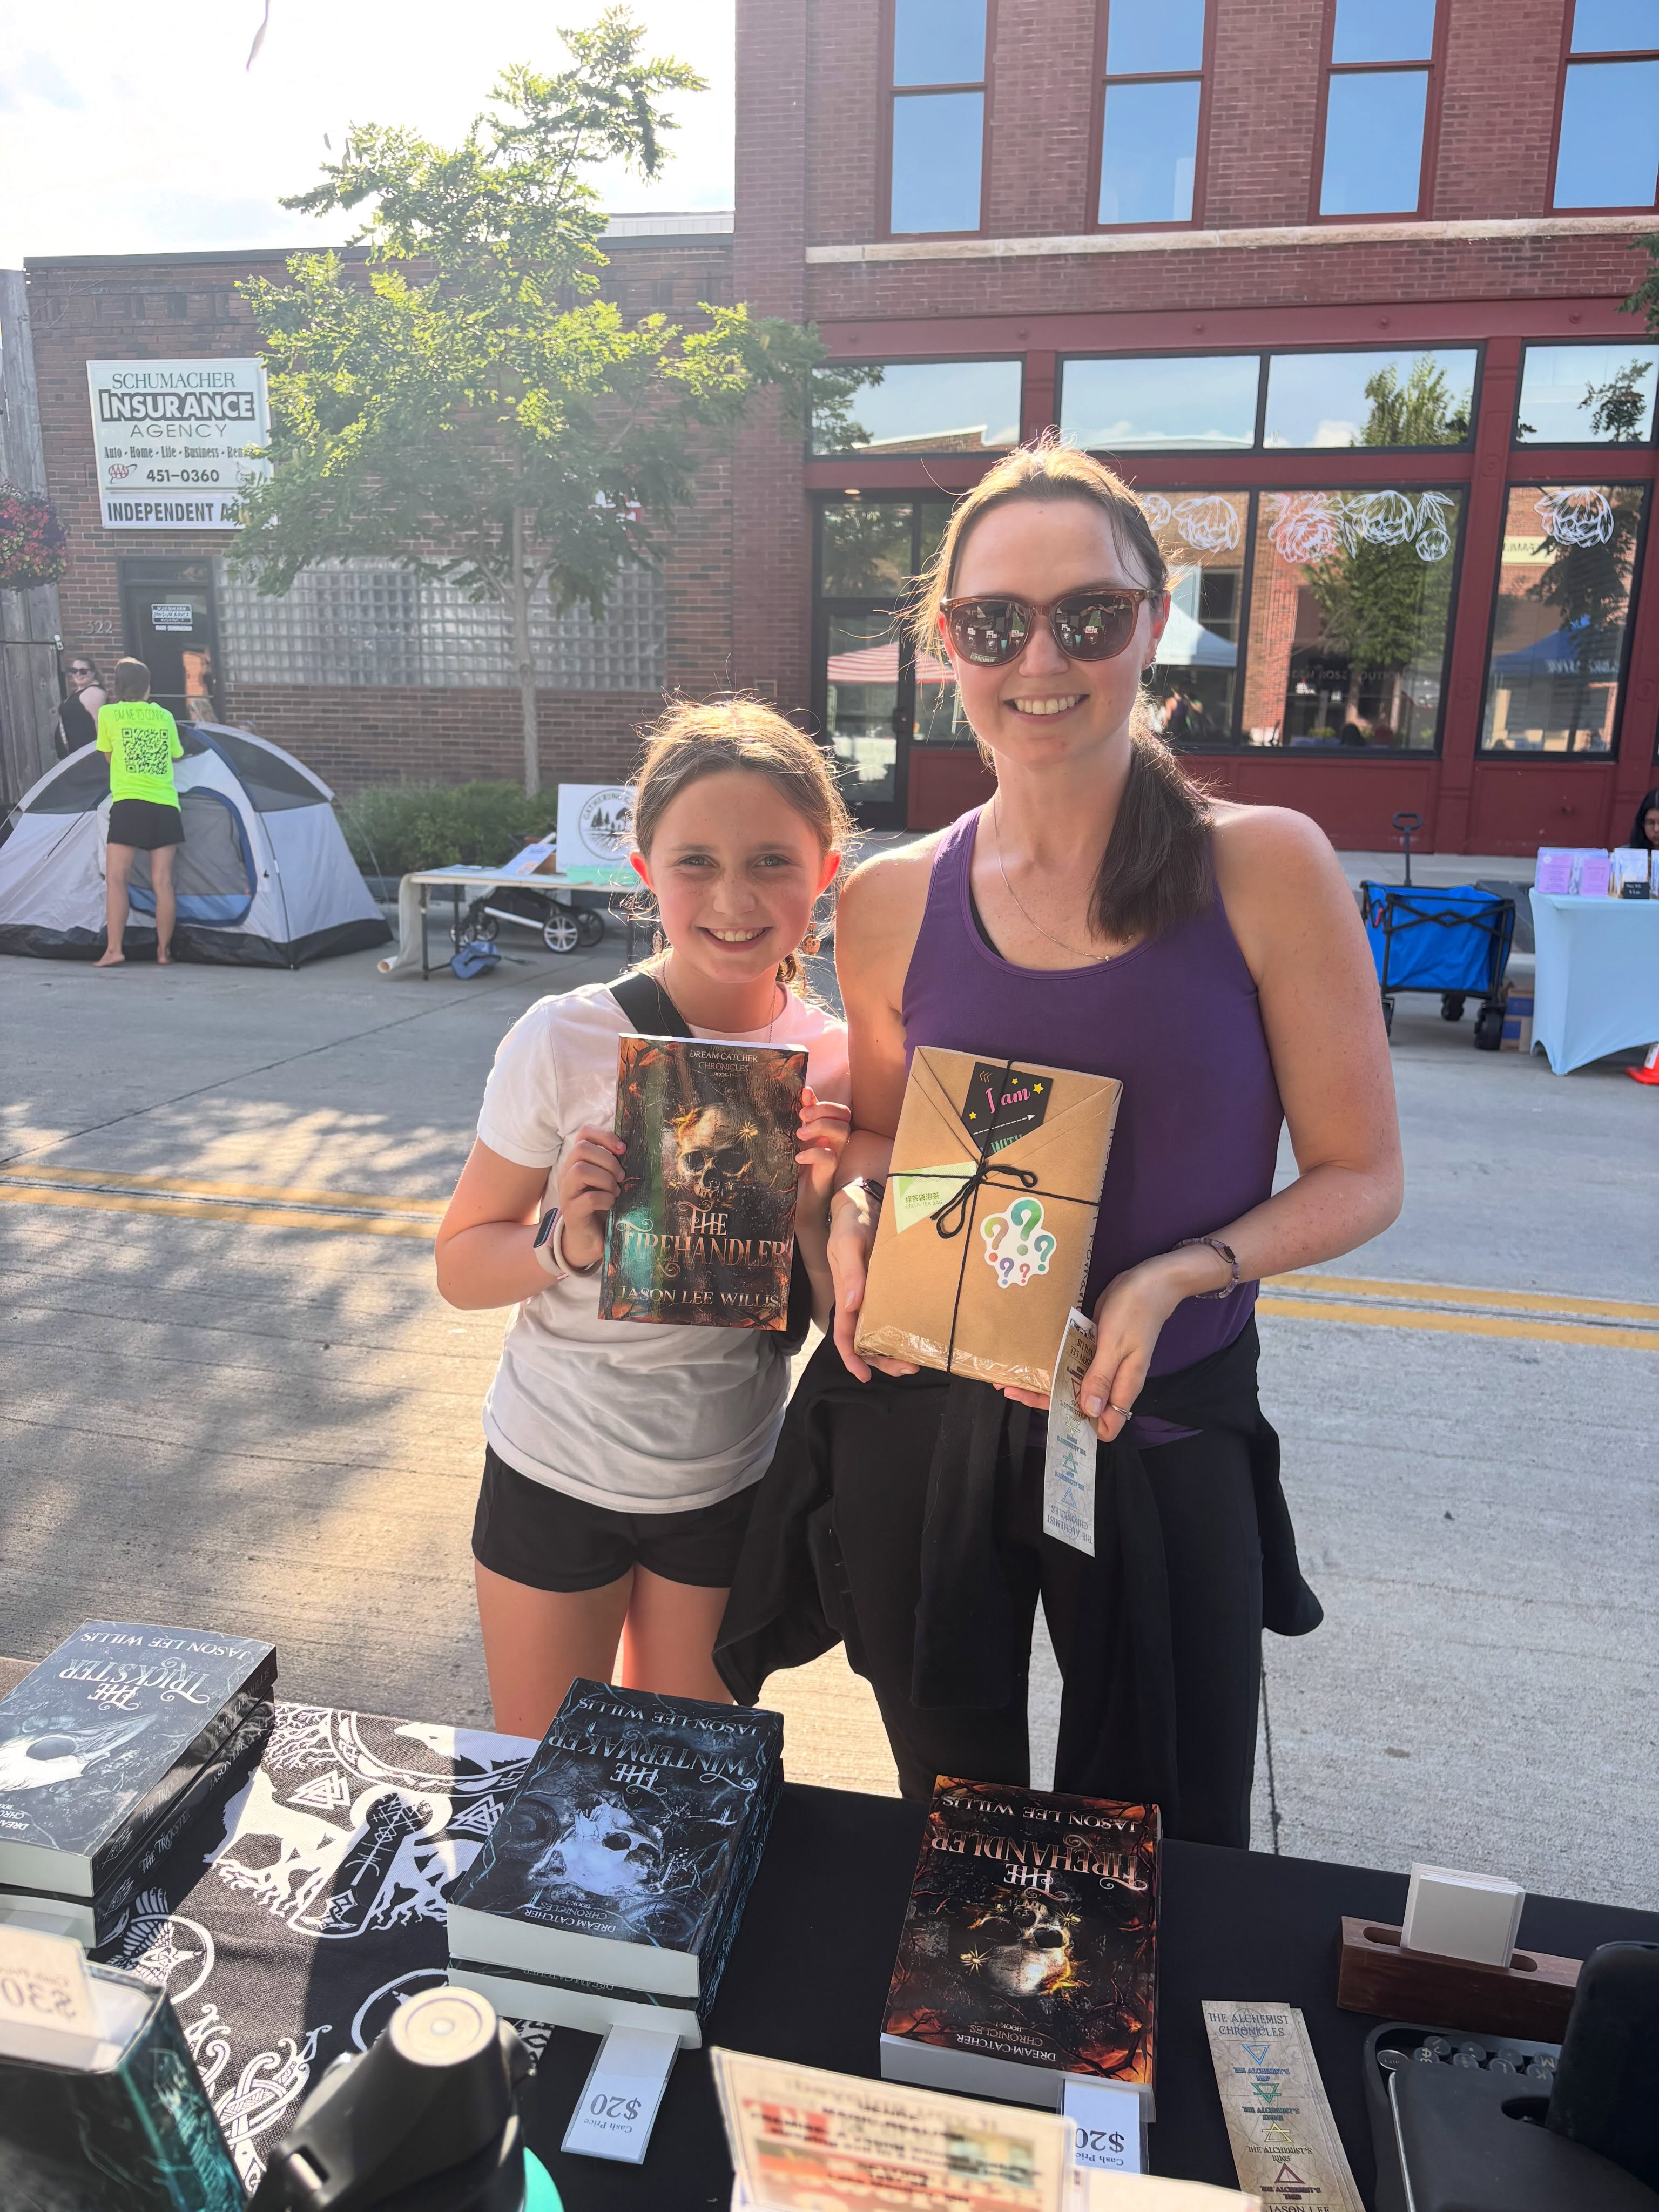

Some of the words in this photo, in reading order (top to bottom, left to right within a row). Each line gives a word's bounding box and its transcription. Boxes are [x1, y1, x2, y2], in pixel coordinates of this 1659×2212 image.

[112, 372, 235, 389] SCHUMACHER
[98, 389, 255, 422] INSURANCE
[130, 424, 227, 438] AGENCY
[104, 446, 122, 458] Auto
[130, 446, 153, 458] Home
[161, 446, 177, 458] Life
[184, 446, 219, 458] Business
[146, 469, 220, 482] 451-0360
[107, 503, 213, 521] INDEPENDENT
[86, 620, 113, 634] 322
[690, 1050, 719, 1060] DREAM
[720, 1053, 758, 1062] CATCHER
[698, 1062, 749, 1073] CHRONICLES
[986, 1087, 995, 1114] I
[1001, 1088, 1031, 1106] am
[905, 1192, 940, 1203] 绿茶袋泡茶
[679, 1201, 729, 1236] THE
[619, 1286, 676, 1305] JASON
[682, 1290, 714, 1306] LEE
[720, 1292, 780, 1308] WILLIS
[1070, 1345, 1080, 1360] LEE
[1076, 1338, 1094, 1357] WILLIS
[1051, 1505, 1088, 1530] CHRONICLES
[1047, 1514, 1080, 1539] ALCHEMIST
[1082, 1534, 1093, 1545] THE
[80, 1631, 144, 1647] WILLIS
[149, 1636, 184, 1652] LEE
[186, 1640, 253, 1661] JASON
[59, 1656, 211, 1707] TRICKSTER
[86, 1684, 140, 1712] THE
[578, 1697, 645, 1722] WILLIS
[651, 1710, 691, 1728] LEE
[689, 1715, 761, 1737] JASON
[548, 1725, 759, 1793] WINTERMAKER
[610, 1763, 668, 1797] THE
[942, 1797, 1015, 1817] WILLIS
[1022, 1806, 1061, 1823] LEE
[1068, 1811, 1136, 1833] JASON
[931, 1826, 1148, 1891] FIREHANDLER
[1003, 1863, 1069, 1900] THE
[539, 1901, 608, 1920] CHRONICLES
[572, 1900, 592, 1909] BOOK
[524, 1908, 576, 1928] CATCHER
[576, 1917, 617, 1933] DREAM
[1002, 2022, 1022, 2032] BOOK
[1208, 2013, 1228, 2022] THE
[1231, 2014, 1290, 2025] ALCHEMIST
[968, 2024, 1043, 2047] CHRONICLES
[1218, 2026, 1285, 2038] CHRONICLES
[1247, 2067, 1290, 2075] ALCHEMIST'S
[590, 2093, 642, 2122] $20
[583, 2117, 608, 2129] Price
[609, 2122, 633, 2134] Cash
[1075, 2128, 1125, 2154] $20
[1075, 2152, 1096, 2162] Pric
[1246, 2146, 1263, 2154] THE
[1263, 2146, 1313, 2155] ALCHEMIST'S
[1272, 2154, 1291, 2163] RING
[1099, 2155, 1124, 2166] Cash
